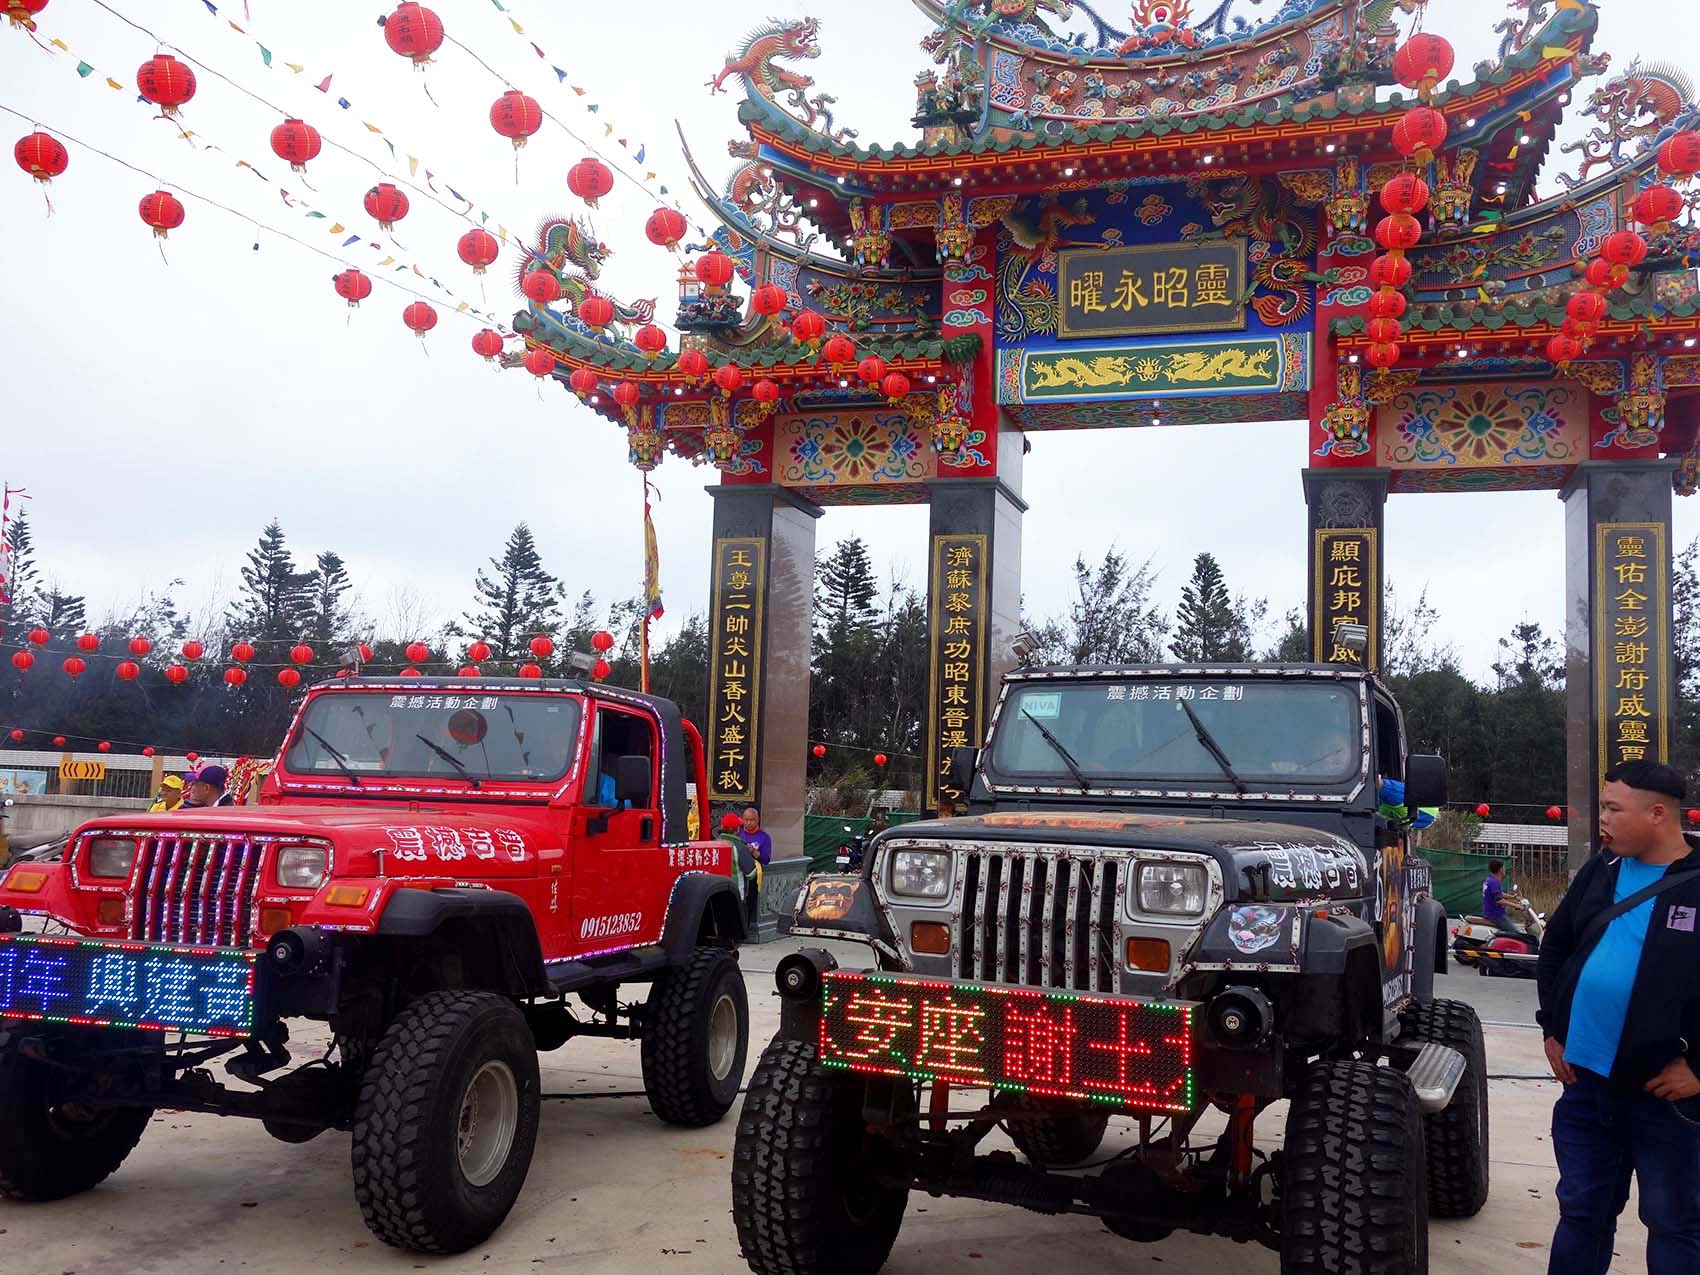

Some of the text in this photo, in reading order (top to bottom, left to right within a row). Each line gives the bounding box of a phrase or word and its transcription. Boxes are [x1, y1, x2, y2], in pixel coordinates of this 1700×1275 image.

[717, 550, 753, 791] 王尊二帥尖山香火盛千秋
[389, 695, 499, 711] 震撼活動企劃
[1106, 685, 1245, 701] 震撼活動企劃
[580, 911, 642, 939] 0915123852
